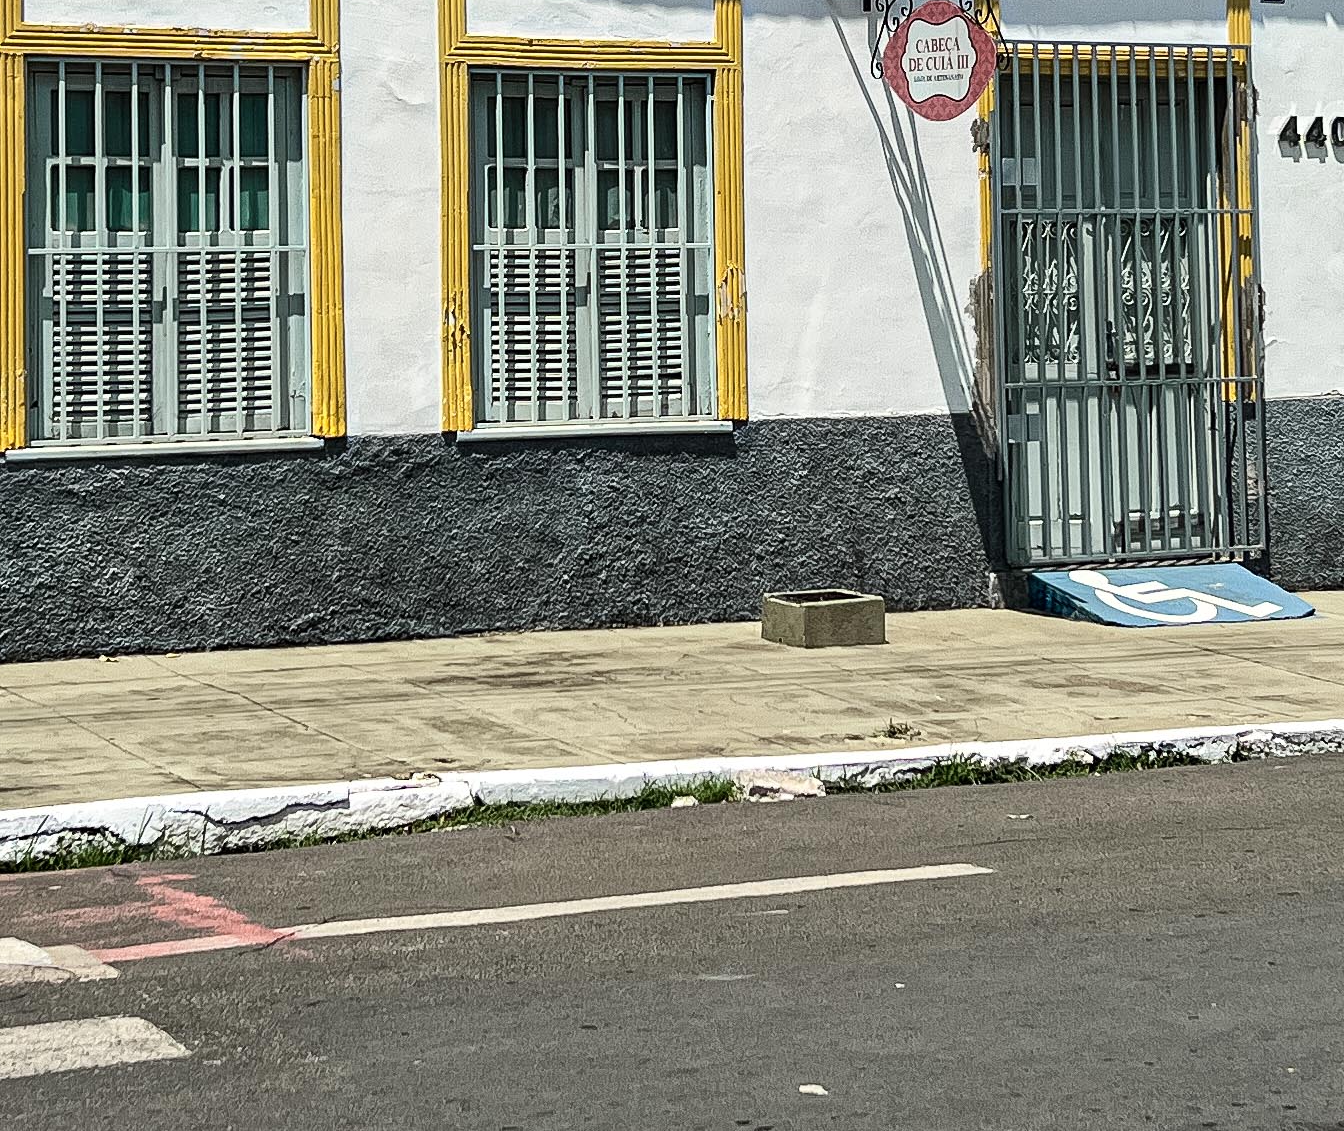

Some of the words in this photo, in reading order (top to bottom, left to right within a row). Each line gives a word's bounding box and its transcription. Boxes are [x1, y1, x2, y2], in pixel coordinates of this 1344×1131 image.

[915, 36, 961, 55] CABEÇA
[908, 57, 924, 72] DE
[925, 55, 954, 71] CUIA
[957, 54, 969, 70] III
